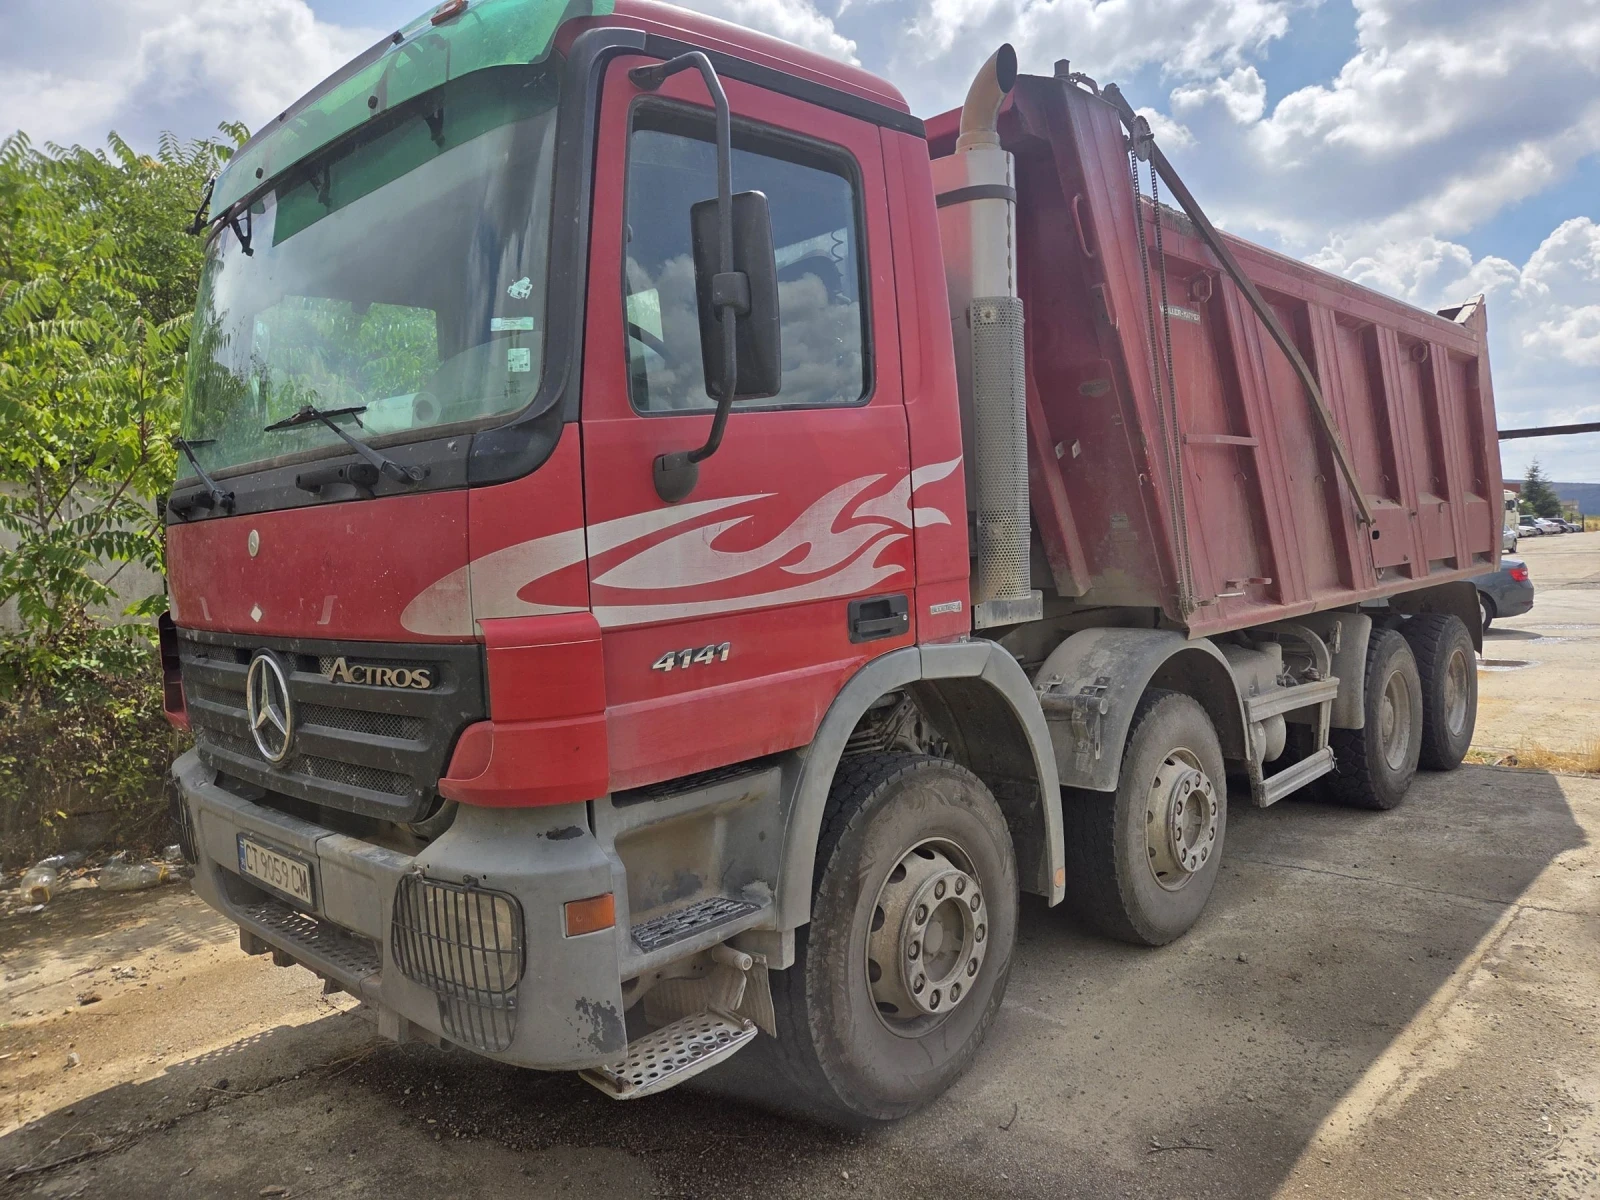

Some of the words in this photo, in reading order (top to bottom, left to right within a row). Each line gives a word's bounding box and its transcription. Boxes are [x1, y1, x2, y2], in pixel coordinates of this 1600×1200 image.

[652, 642, 730, 671] 4141
[245, 844, 258, 874] CT
[260, 852, 289, 888] 9059
[291, 865, 309, 899] CM
